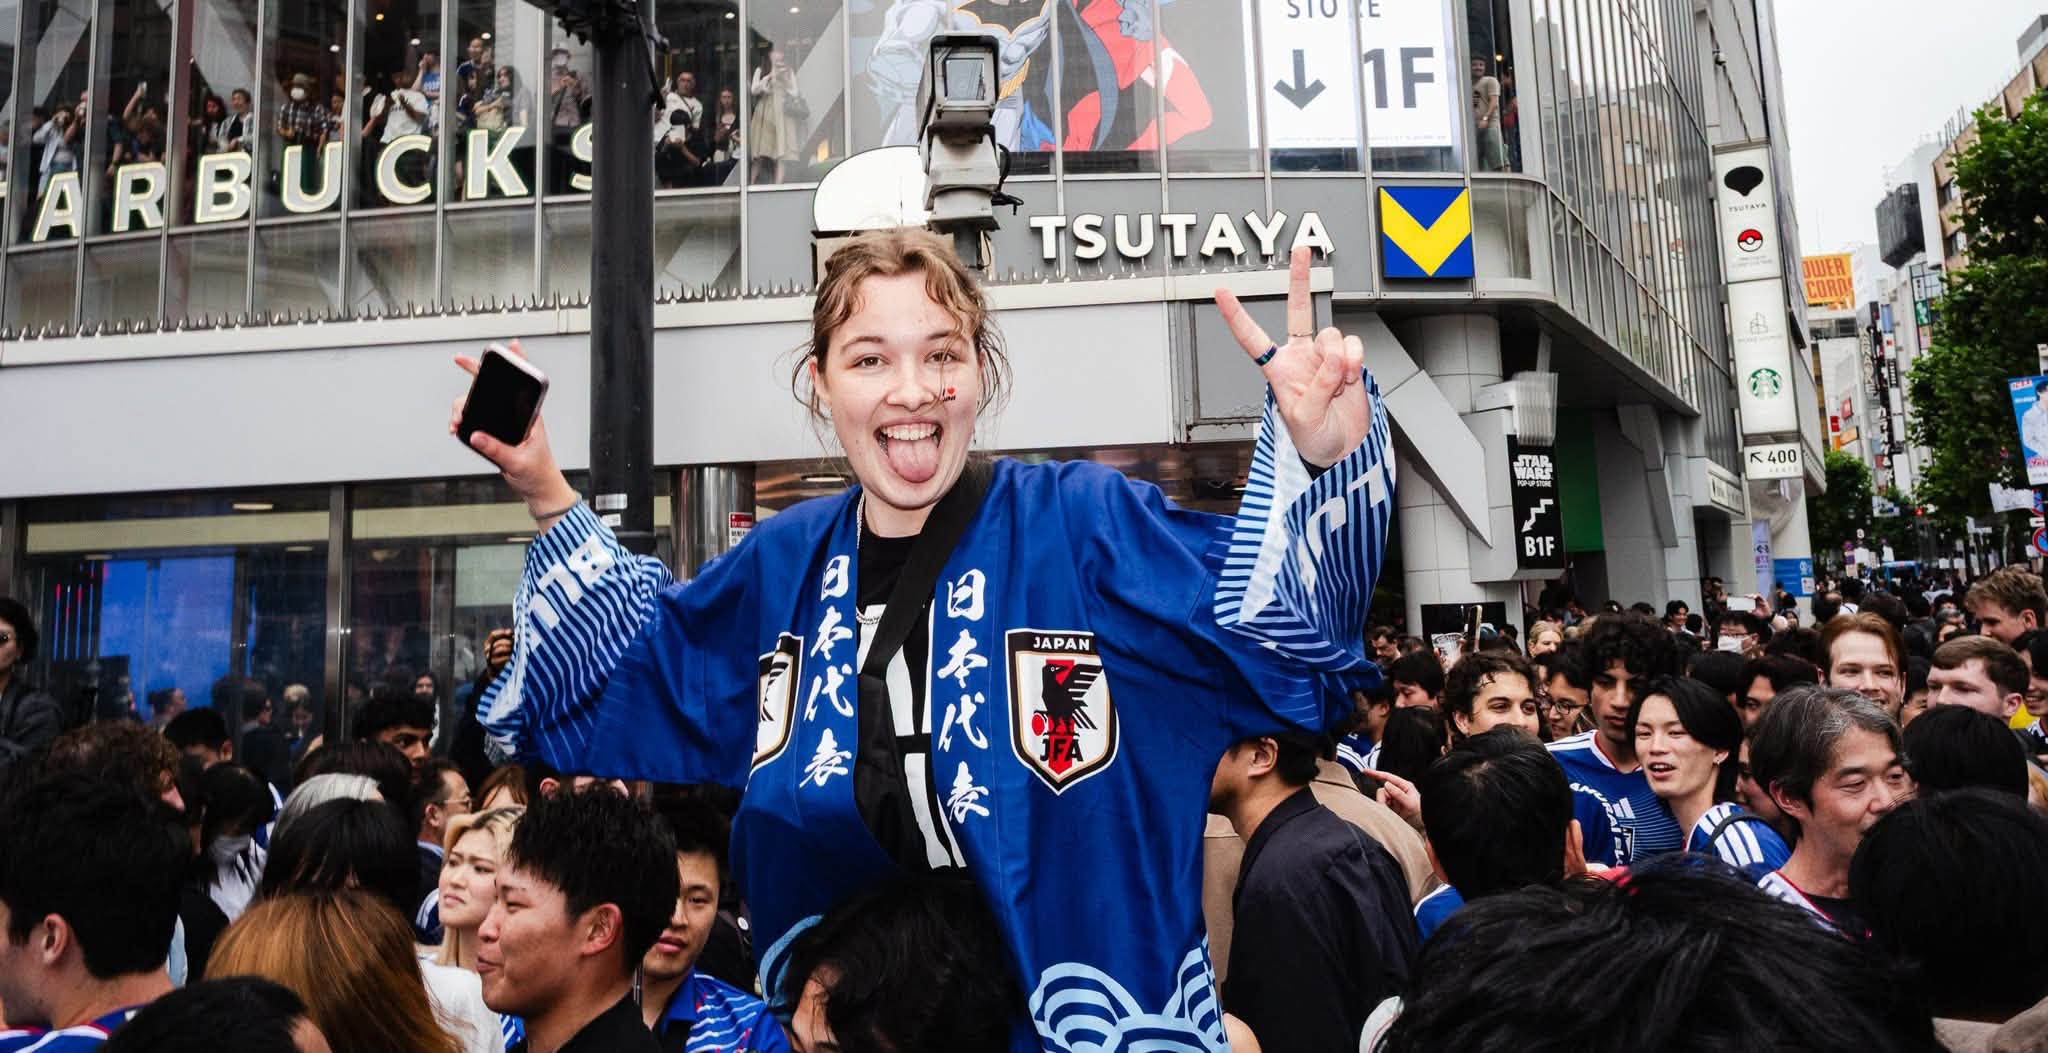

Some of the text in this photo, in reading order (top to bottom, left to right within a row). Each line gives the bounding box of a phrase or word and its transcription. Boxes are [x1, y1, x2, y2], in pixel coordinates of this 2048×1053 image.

[1287, 0, 1381, 19] STOE
[1363, 47, 1435, 109] 1F
[0, 122, 593, 242] ARBUCK
[1728, 202, 1767, 213] TSUTAYA
[1028, 209, 1337, 260] TSUTAYA
[1801, 257, 1846, 279] OWER
[1805, 277, 1853, 299] CORD
[1512, 453, 1553, 468] STAR
[1767, 449, 1798, 465] 400
[1513, 466, 1554, 480] WARS
[1524, 535, 1555, 557] B1F
[527, 535, 616, 652] BLU
[1032, 635, 1091, 651] JAPAN
[799, 554, 855, 789] 日本代表
[937, 567, 991, 825] 日本代表
[1039, 738, 1084, 763] JFA
[1569, 782, 1622, 833] AMURAI
